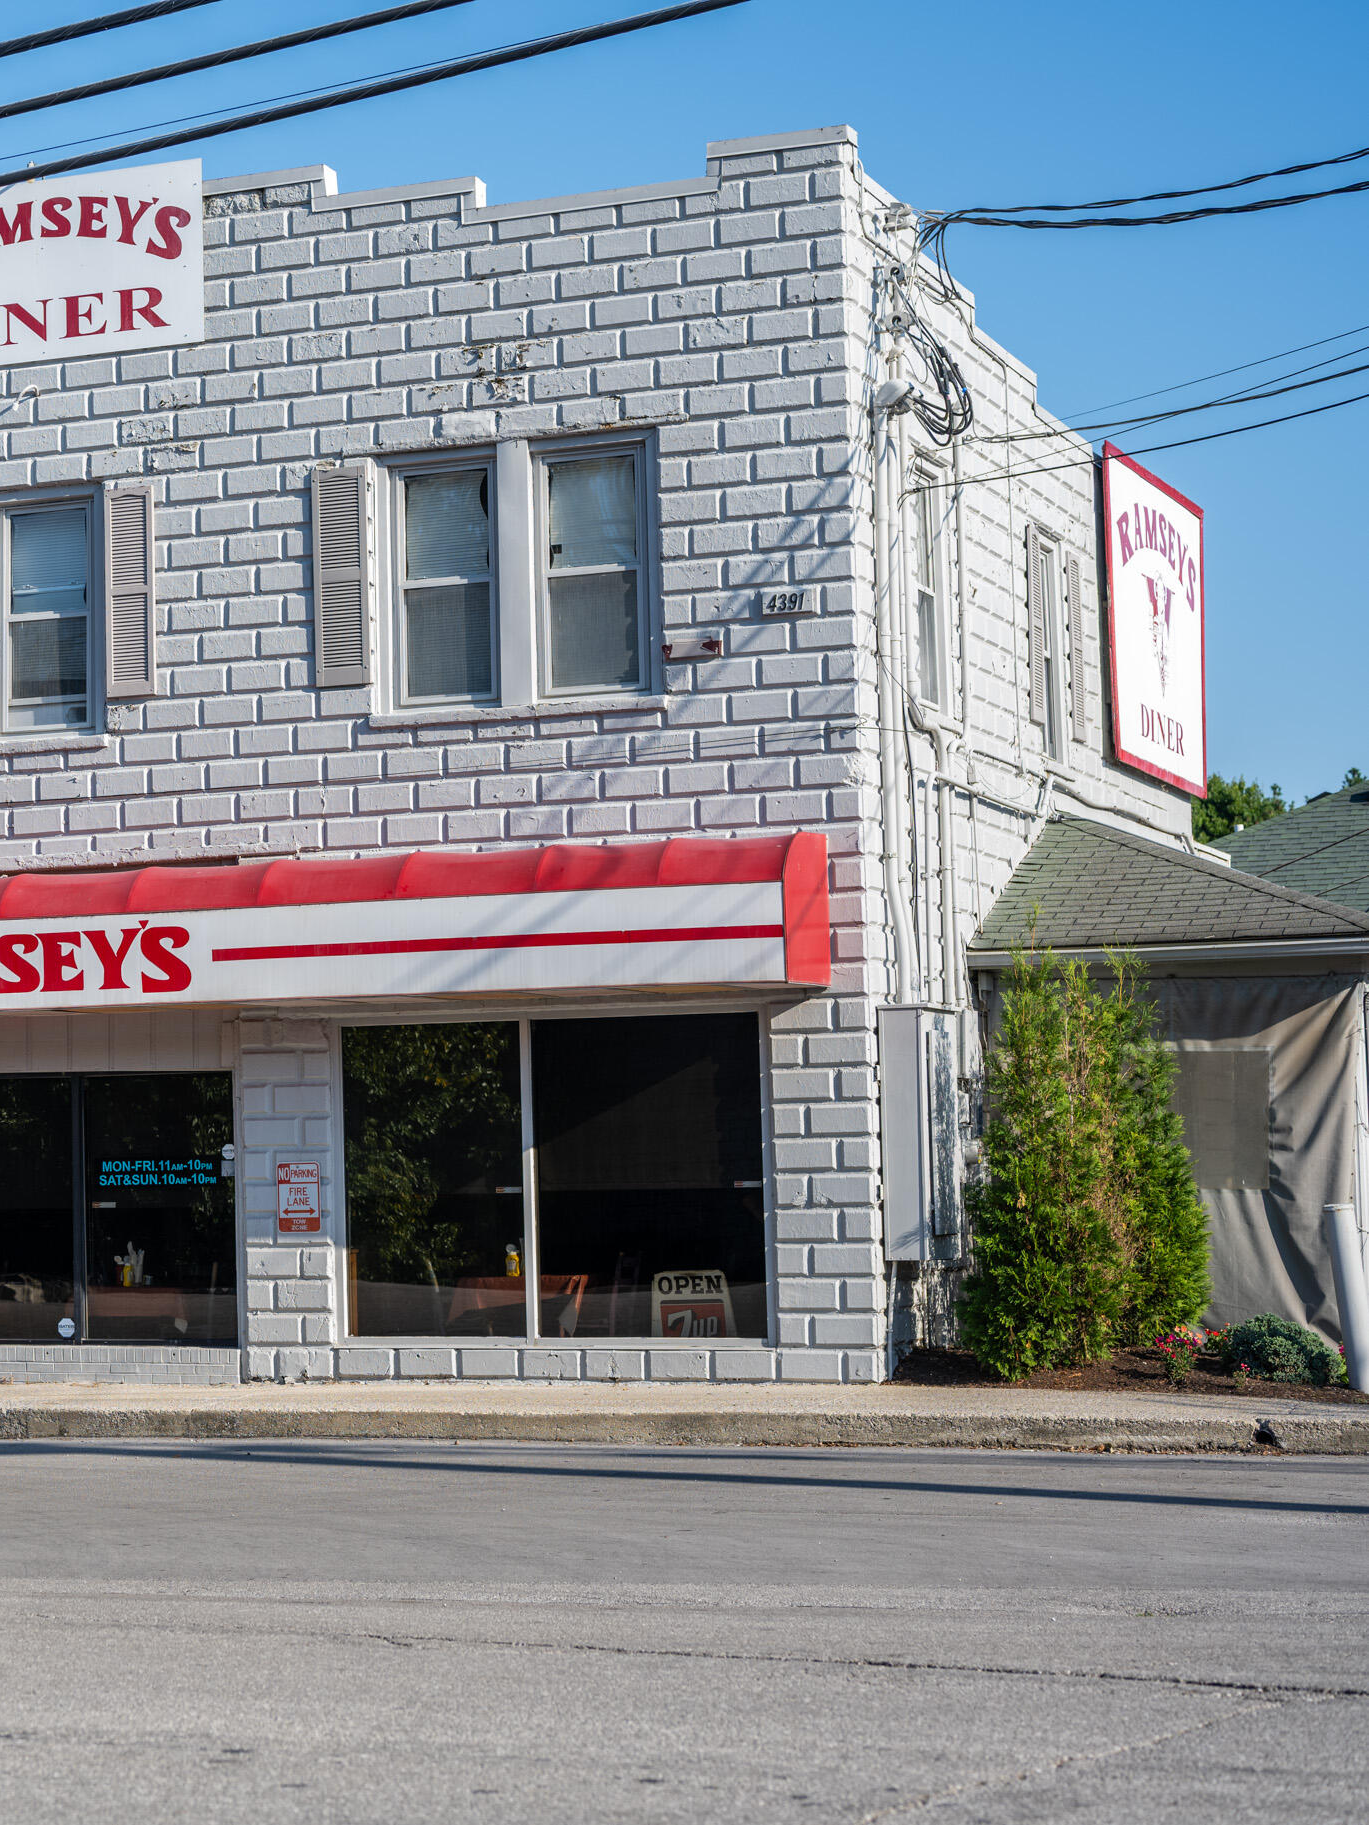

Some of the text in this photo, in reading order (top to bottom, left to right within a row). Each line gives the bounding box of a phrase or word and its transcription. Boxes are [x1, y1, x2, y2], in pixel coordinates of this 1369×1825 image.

[1116, 503, 1196, 613] RAMSEY'S
[765, 592, 805, 612] 4391
[1140, 703, 1185, 757] DINER
[278, 1167, 317, 1180] NO PARKING
[289, 1187, 308, 1196] FIRE
[287, 1197, 310, 1206] LANE
[658, 1275, 724, 1294] OPEN
